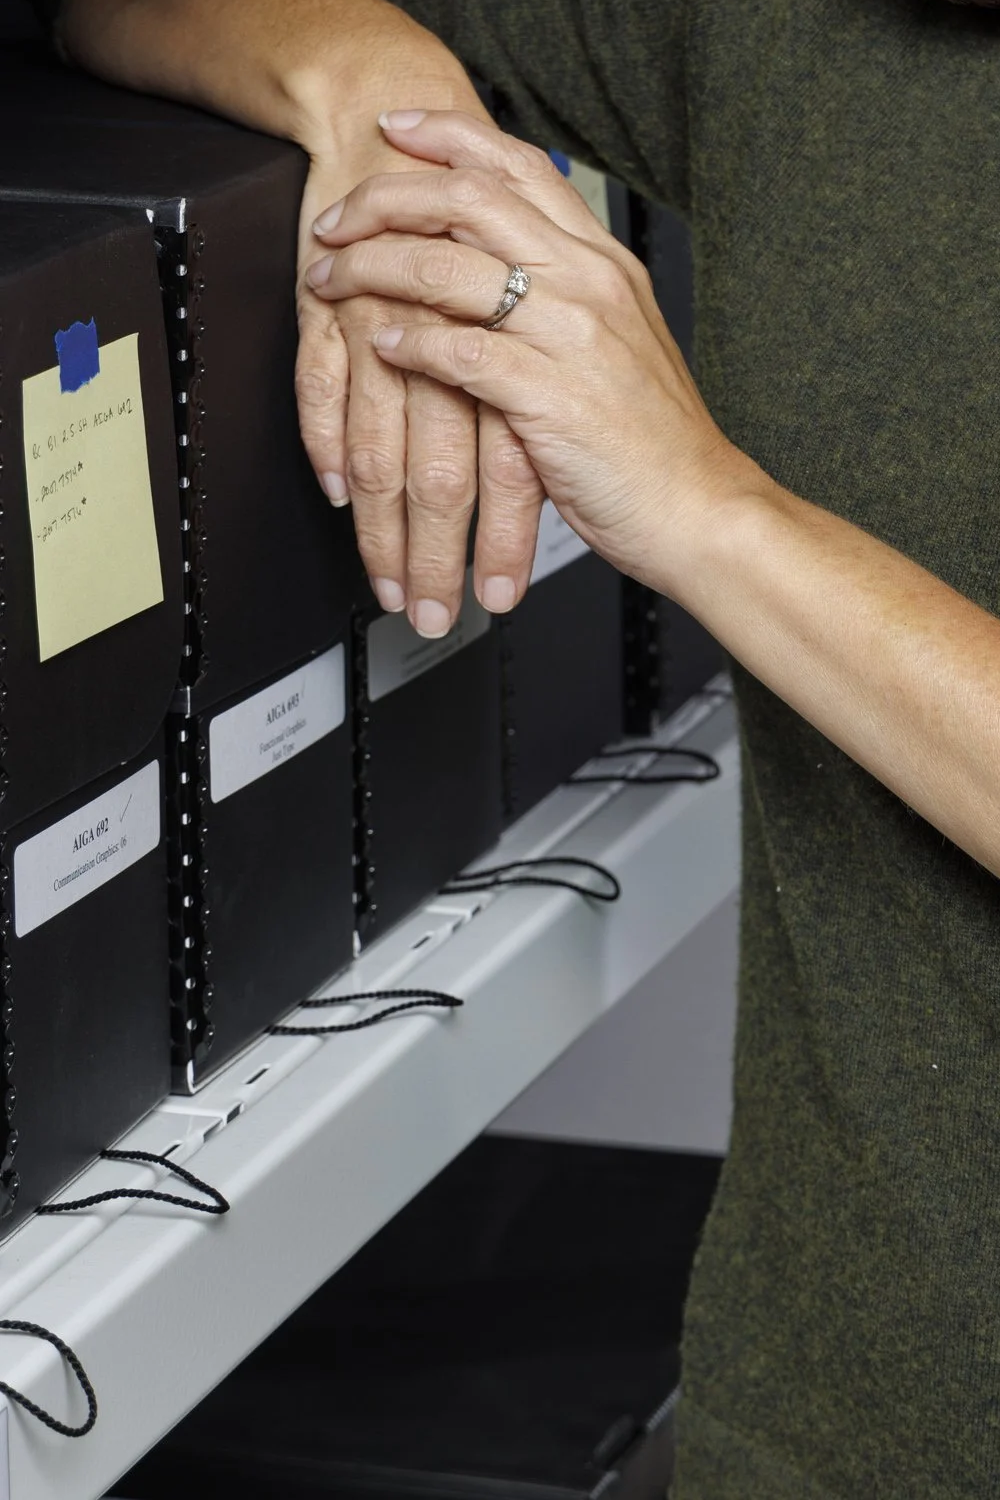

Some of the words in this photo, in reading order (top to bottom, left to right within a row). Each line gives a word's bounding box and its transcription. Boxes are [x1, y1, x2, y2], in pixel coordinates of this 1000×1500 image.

[93, 407, 114, 428] AIGA
[266, 703, 287, 727] AIGA
[287, 693, 300, 712] 693
[72, 827, 95, 854] AIGA
[96, 817, 110, 839] 692
[53, 859, 96, 892] Communication
